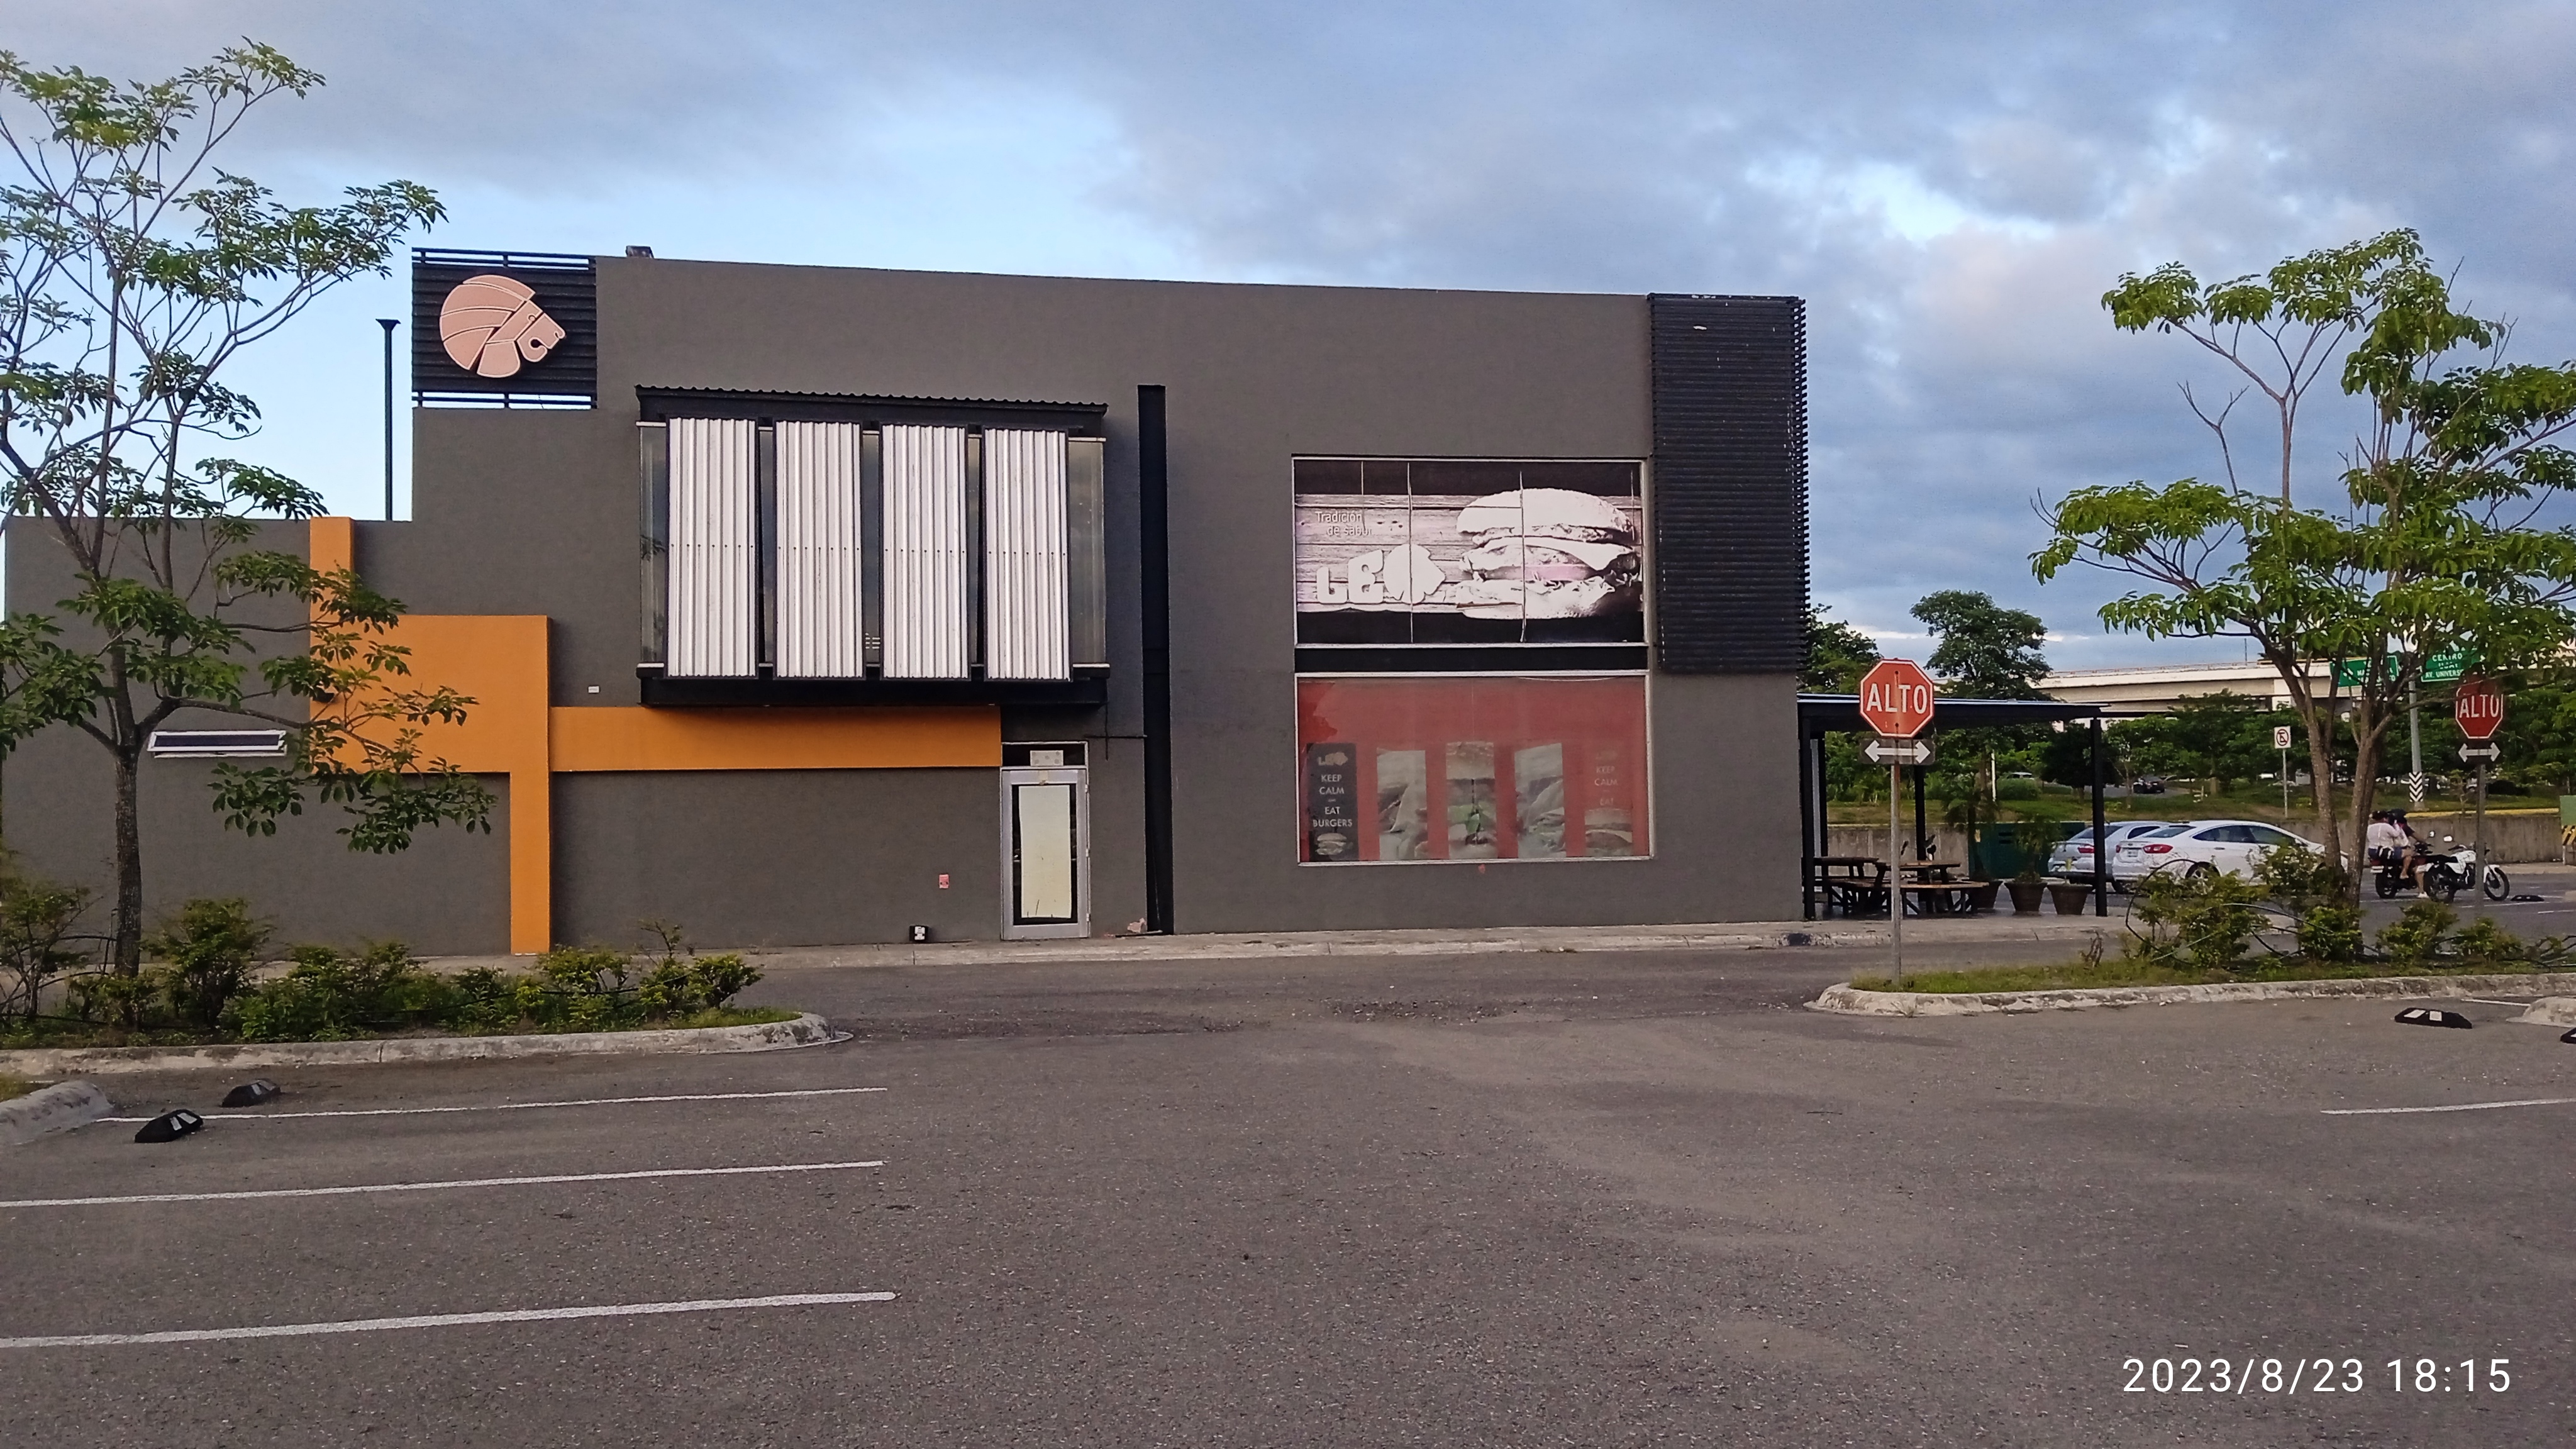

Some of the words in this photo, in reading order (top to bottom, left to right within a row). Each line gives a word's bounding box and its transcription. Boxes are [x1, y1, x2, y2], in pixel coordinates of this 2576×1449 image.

[1316, 511, 1362, 523] Tradición
[1327, 526, 1340, 535] de
[1866, 682, 1928, 714] ALTO
[2459, 694, 2499, 718] ALTO
[1596, 765, 1615, 774] KEEP
[1321, 774, 1342, 782] KEEP
[1594, 778, 1618, 786] CALM
[1319, 786, 1345, 794] CALM
[1324, 806, 1340, 814] EAT
[1313, 819, 1353, 828] BURGERS
